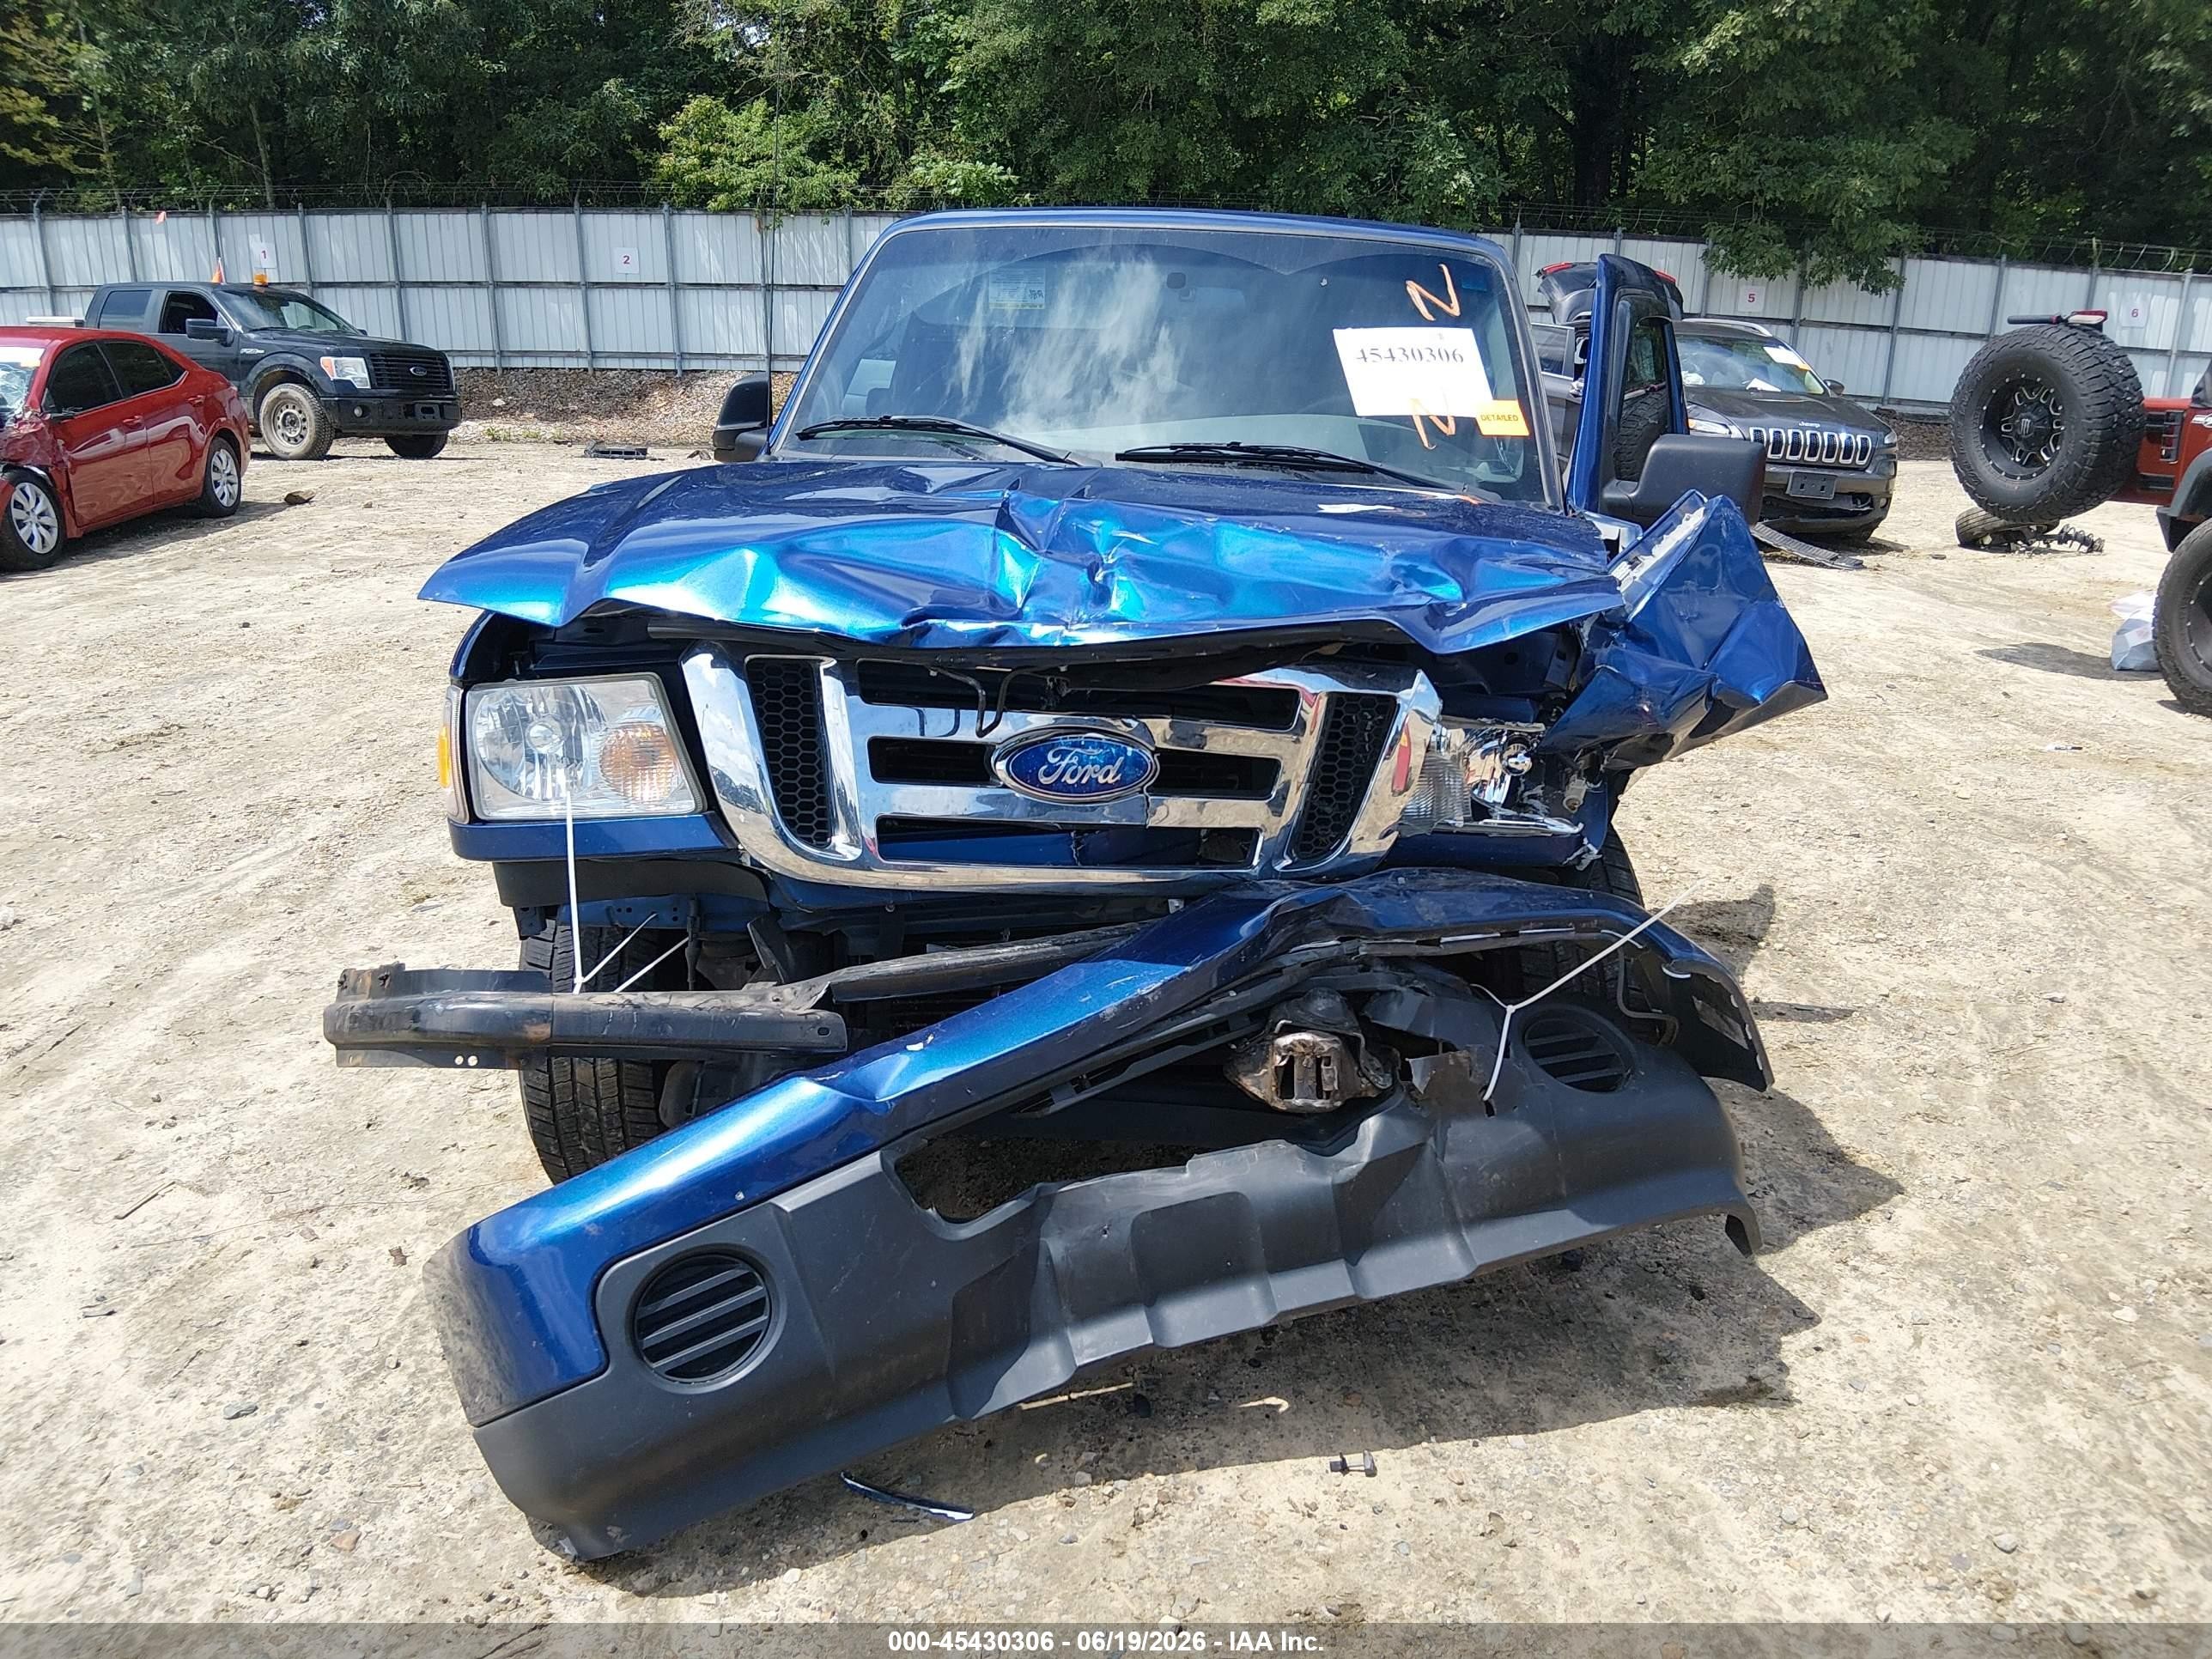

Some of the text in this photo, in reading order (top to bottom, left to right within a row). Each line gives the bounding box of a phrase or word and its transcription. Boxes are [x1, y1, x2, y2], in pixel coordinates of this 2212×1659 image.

[261, 250, 267, 259] 1
[623, 255, 630, 264] 2
[1405, 264, 1461, 321] N
[1747, 293, 1756, 303] 5
[2131, 308, 2139, 318] 6
[1355, 346, 1465, 363] 45430306
[1037, 746, 1125, 785] Ford
